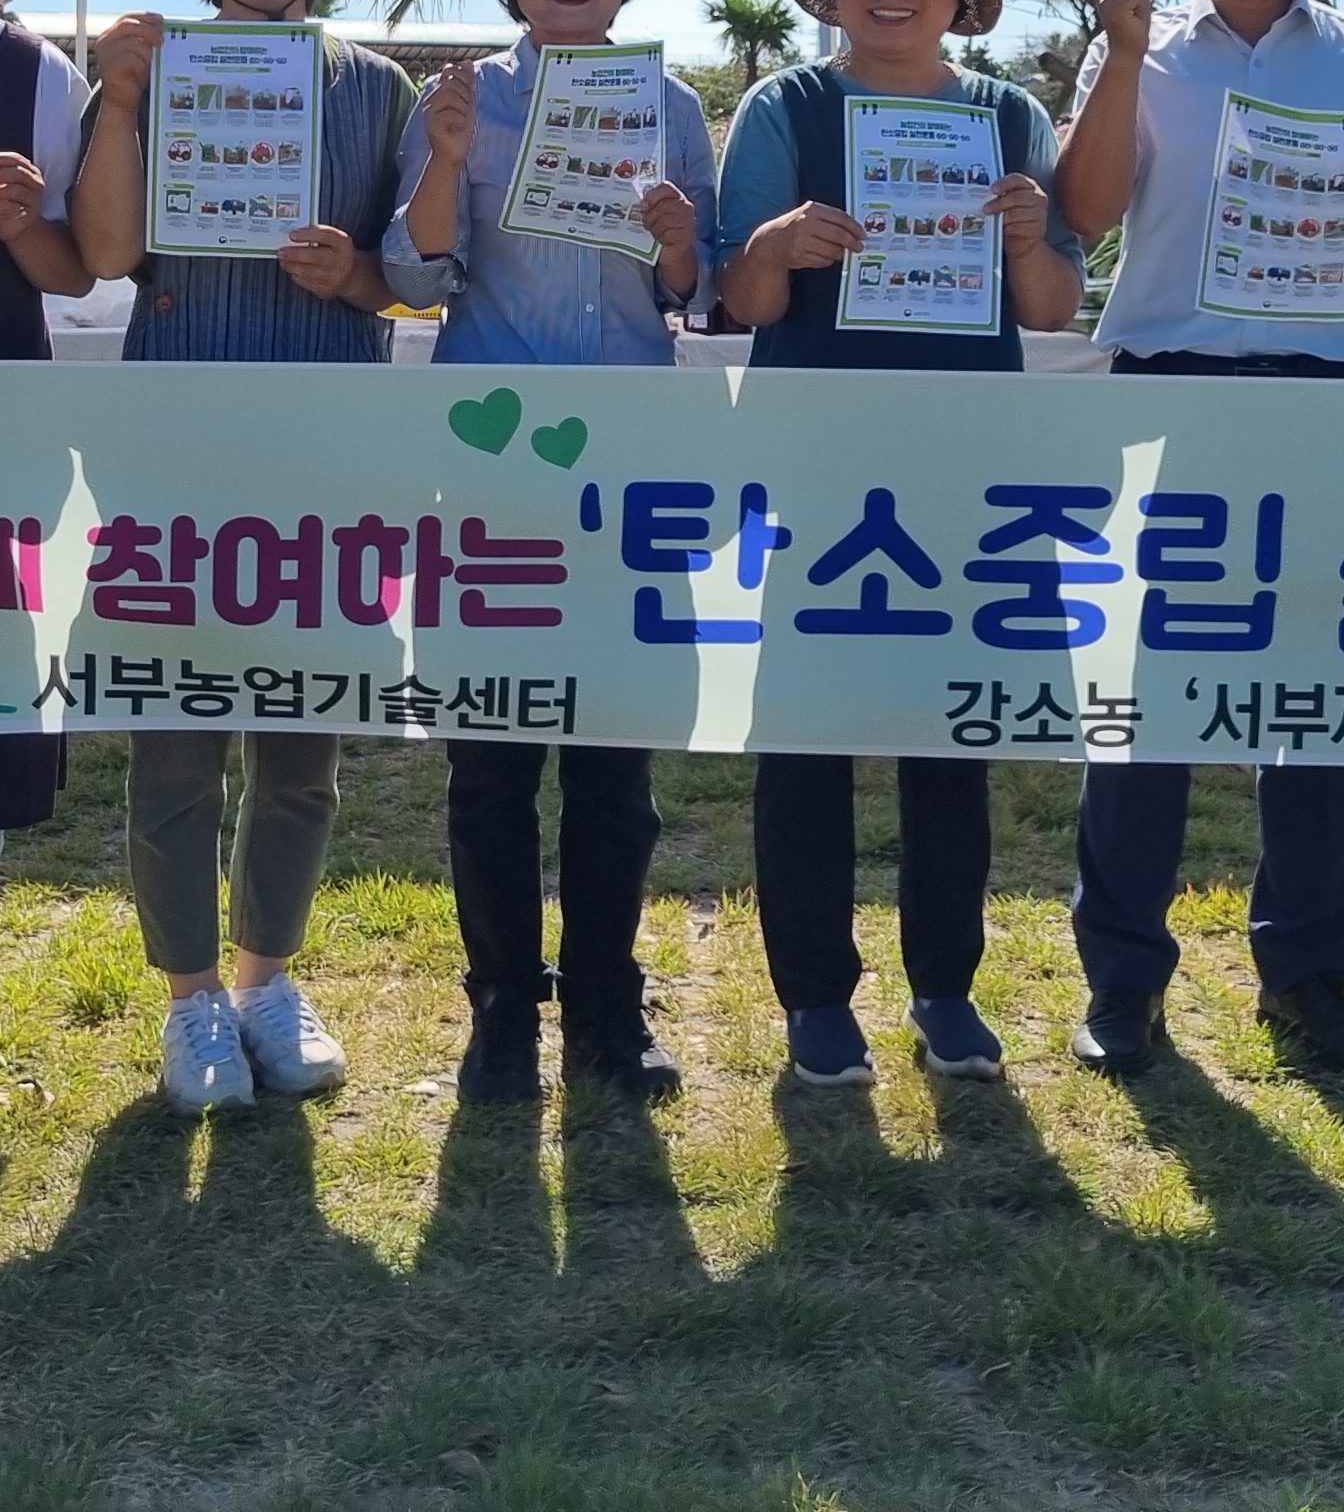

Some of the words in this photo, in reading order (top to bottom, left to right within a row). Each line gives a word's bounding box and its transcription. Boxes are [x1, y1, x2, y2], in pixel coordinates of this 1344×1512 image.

[86, 513, 568, 629] 참여하는
[33, 653, 578, 735] 서부농업기술센터
[944, 680, 1143, 749] 강소농
